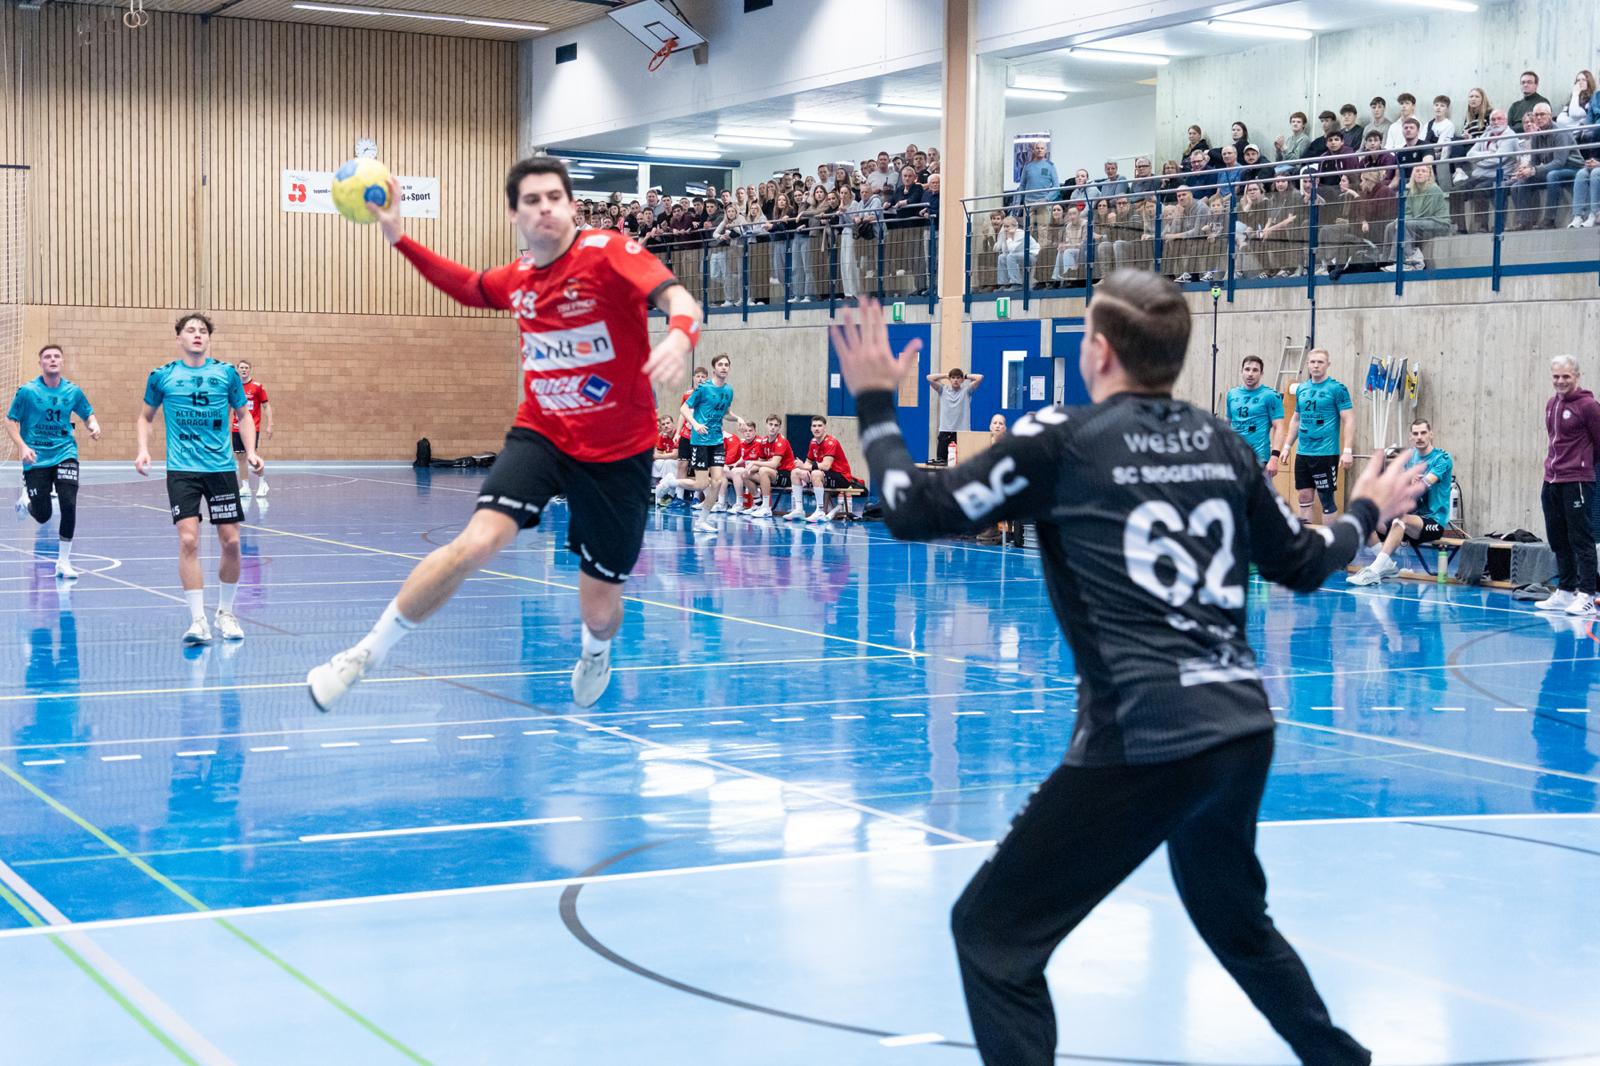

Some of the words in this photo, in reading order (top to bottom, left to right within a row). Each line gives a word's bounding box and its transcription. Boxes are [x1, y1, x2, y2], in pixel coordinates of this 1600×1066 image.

[400, 192, 431, 201] d+Sport
[189, 391, 209, 406] 15
[1305, 400, 1316, 411] 21
[46, 409, 60, 421] 31
[1237, 407, 1249, 418] 13
[1112, 466, 1139, 484] SC
[1123, 498, 1245, 609] 62
